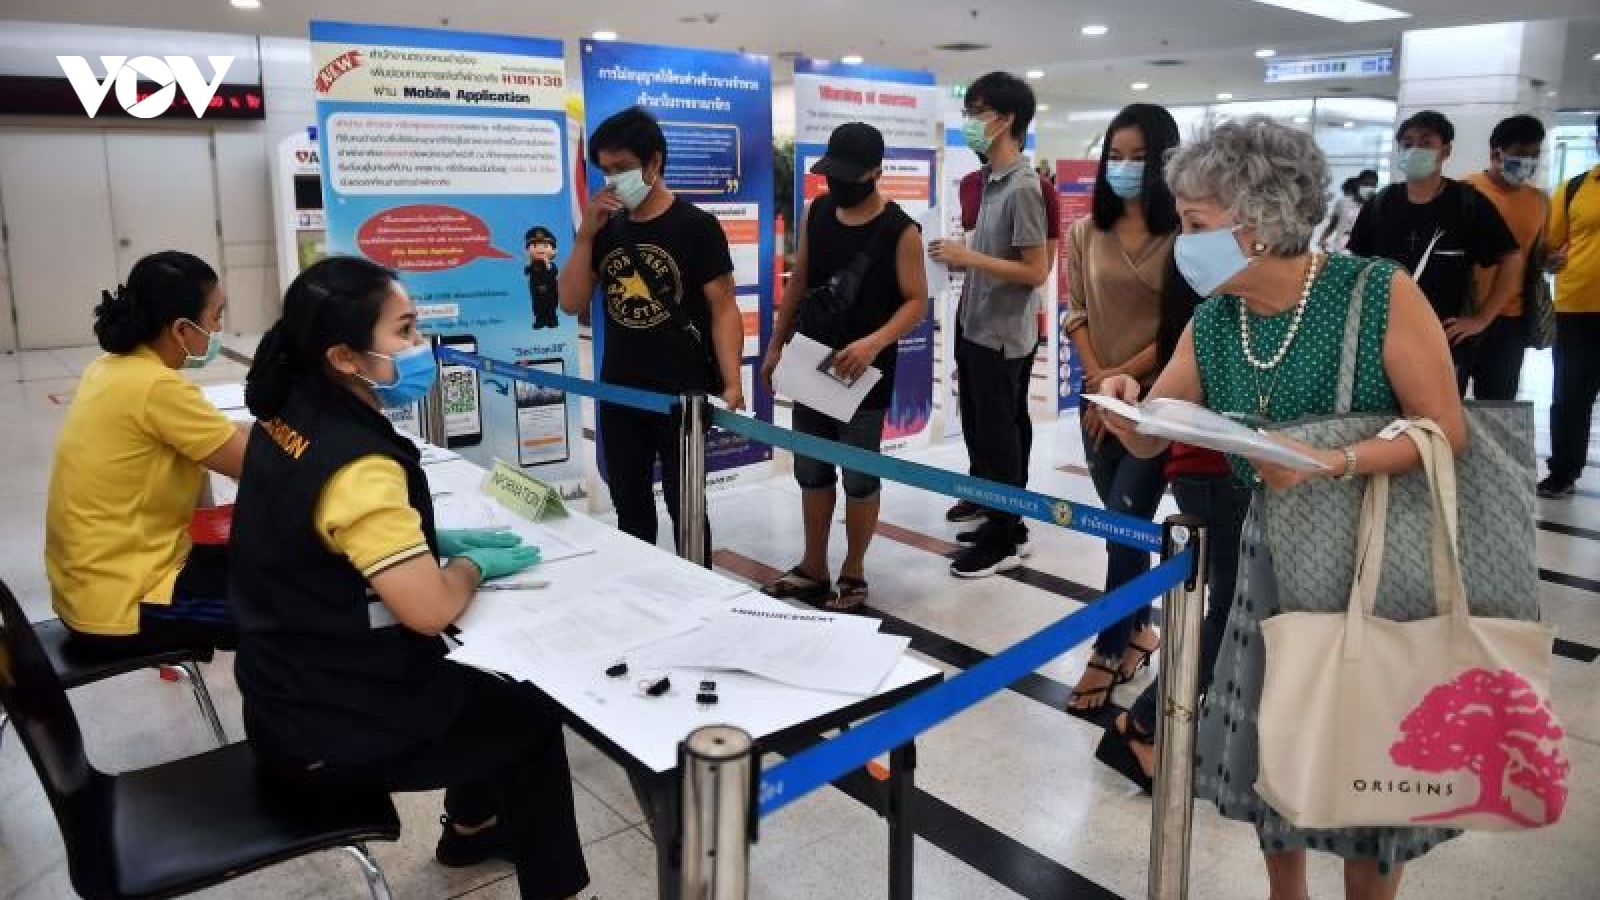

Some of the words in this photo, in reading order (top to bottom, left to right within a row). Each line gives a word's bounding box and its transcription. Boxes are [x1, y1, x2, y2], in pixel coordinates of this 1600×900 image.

[403, 86, 451, 98] Mobile
[455, 89, 531, 103] Application
[729, 607, 837, 622] ANNOUNCEMENT
[1353, 779, 1453, 796] ORIGINS
